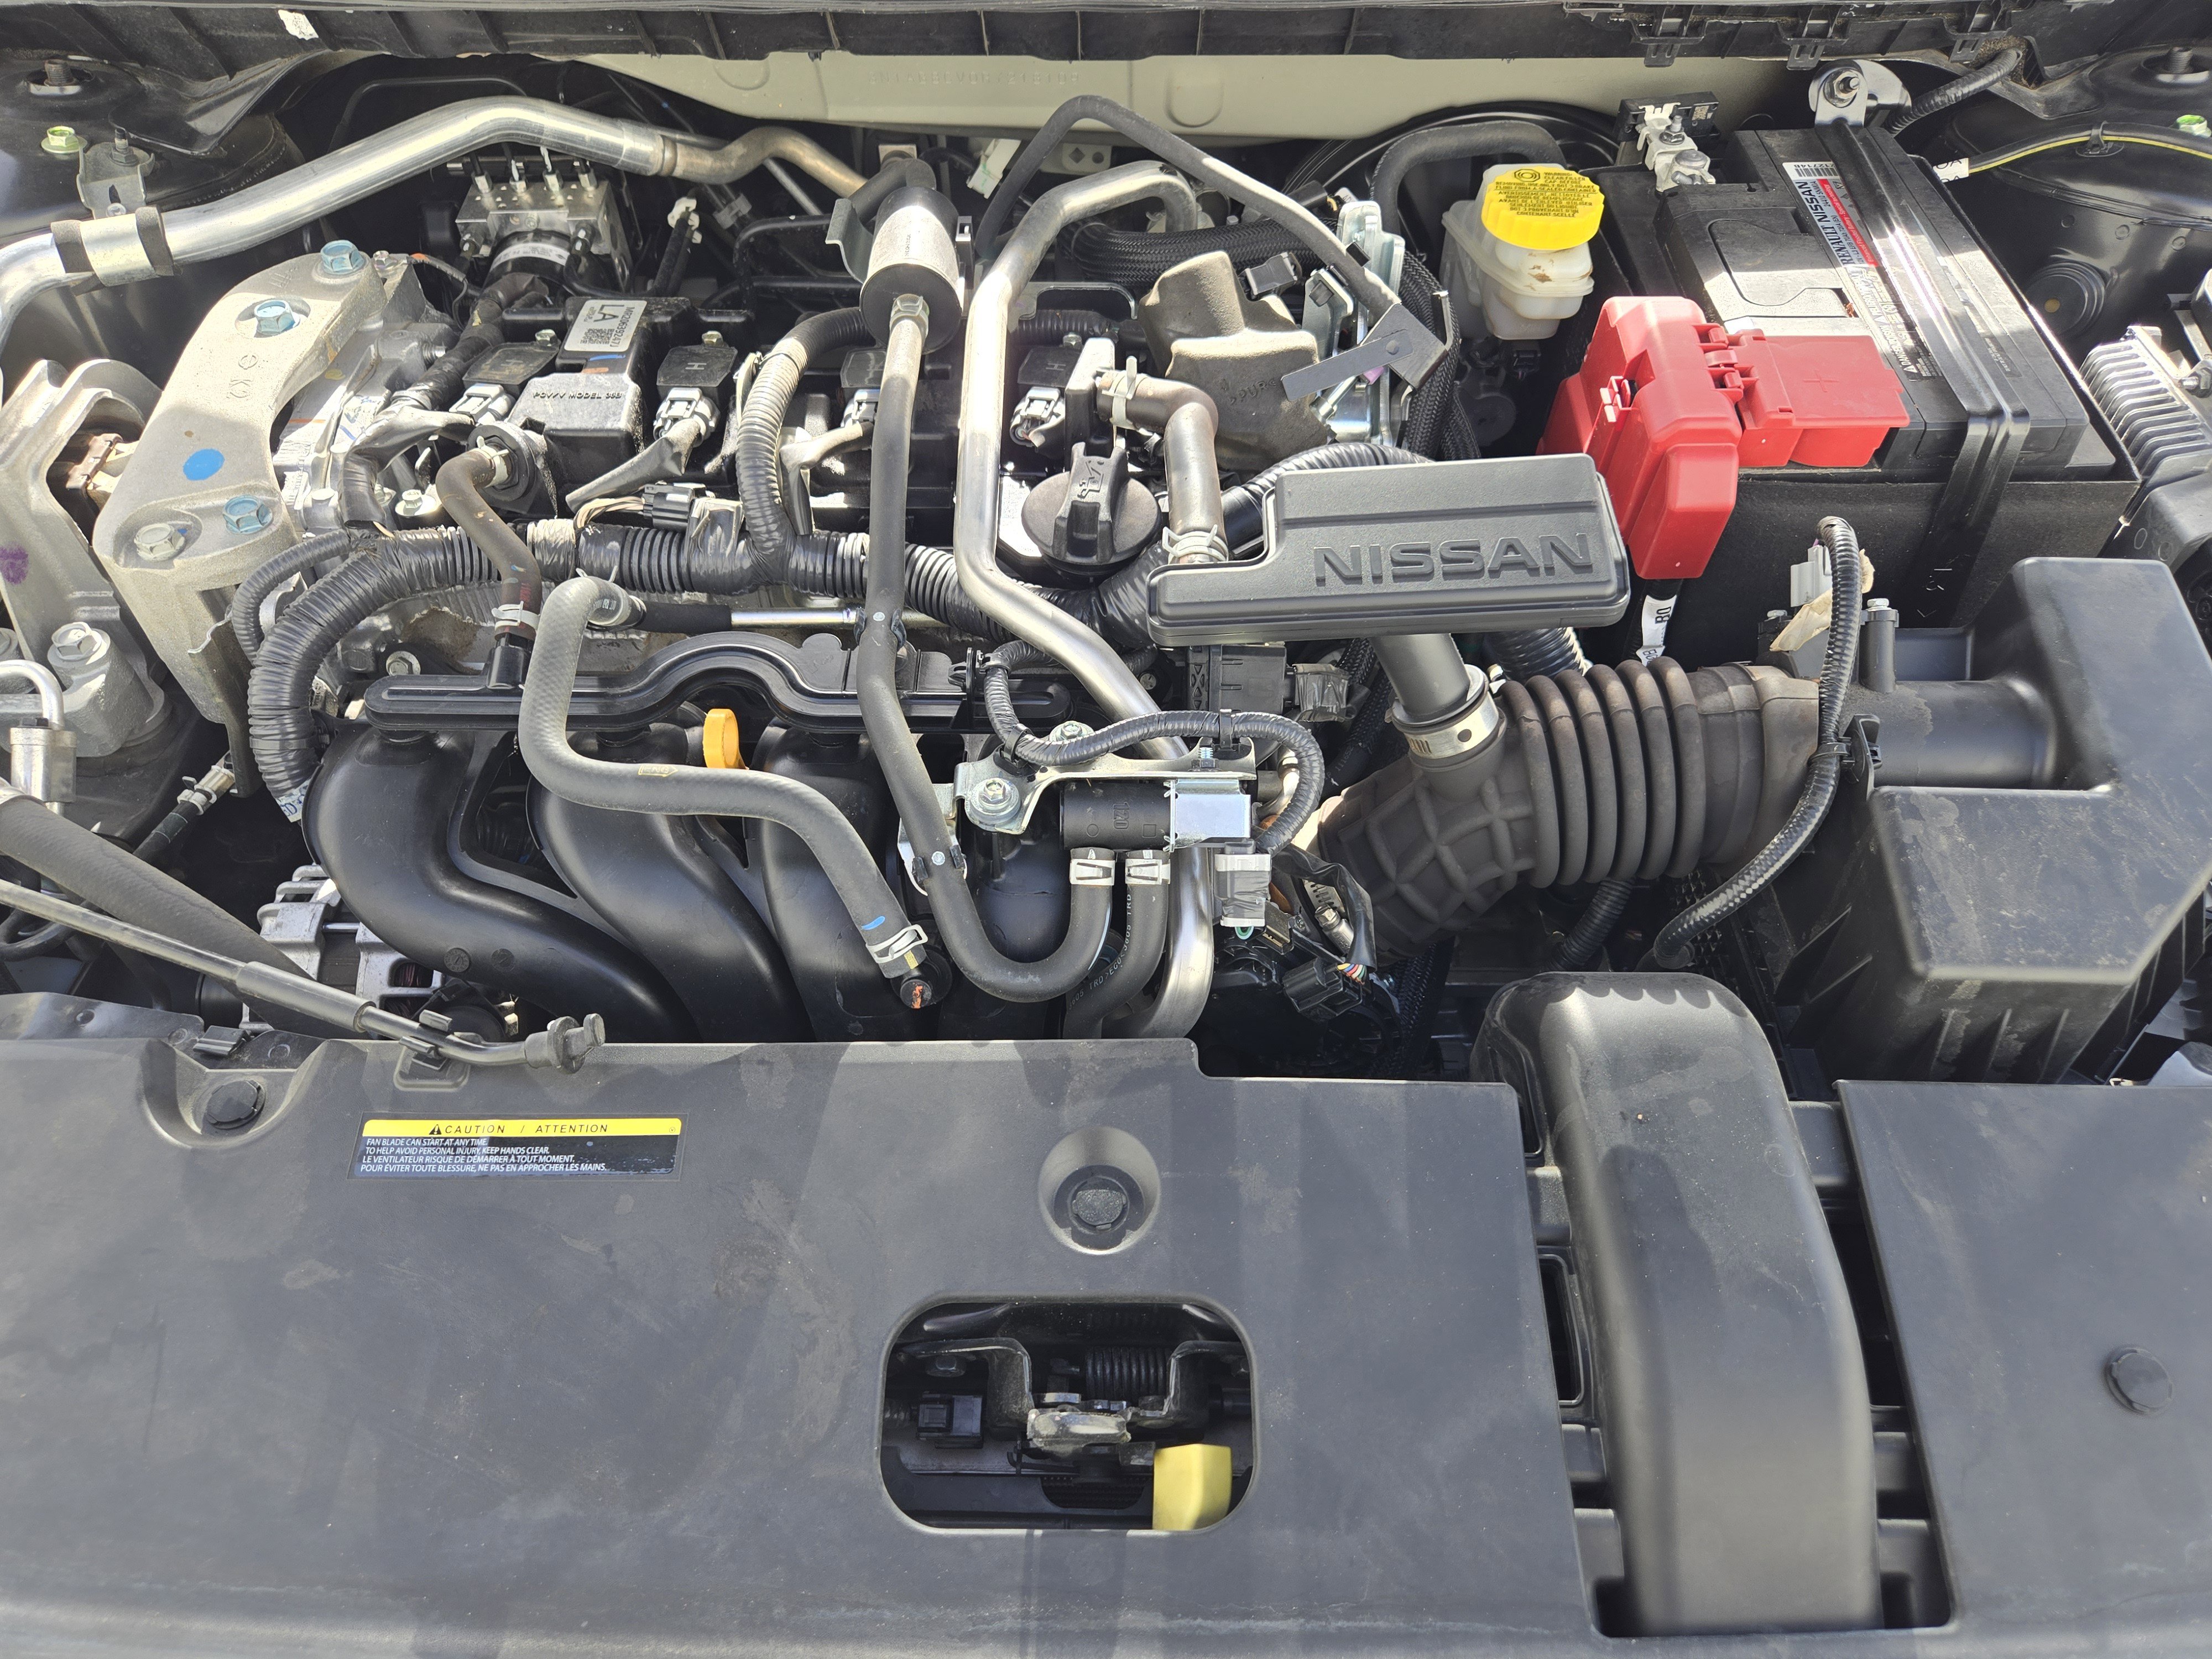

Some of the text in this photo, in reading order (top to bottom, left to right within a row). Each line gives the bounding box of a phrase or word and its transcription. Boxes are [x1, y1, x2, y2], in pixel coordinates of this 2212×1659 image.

[1794, 181, 1855, 264] RENAULT NISSAN
[568, 391, 602, 399] MODEL
[1313, 533, 1594, 585] NISSAN
[1113, 802, 1130, 830] 120
[445, 1125, 505, 1134] CAUTION
[535, 1124, 608, 1134] ATTENTION
[422, 1138, 443, 1146] START
[425, 1155, 454, 1164] RISQUE
[466, 1154, 510, 1163] DÉMARRER
[384, 1163, 410, 1172] ÉVITER
[437, 1164, 477, 1172] BLESSURE,
[580, 1163, 607, 1171] MAINS.
